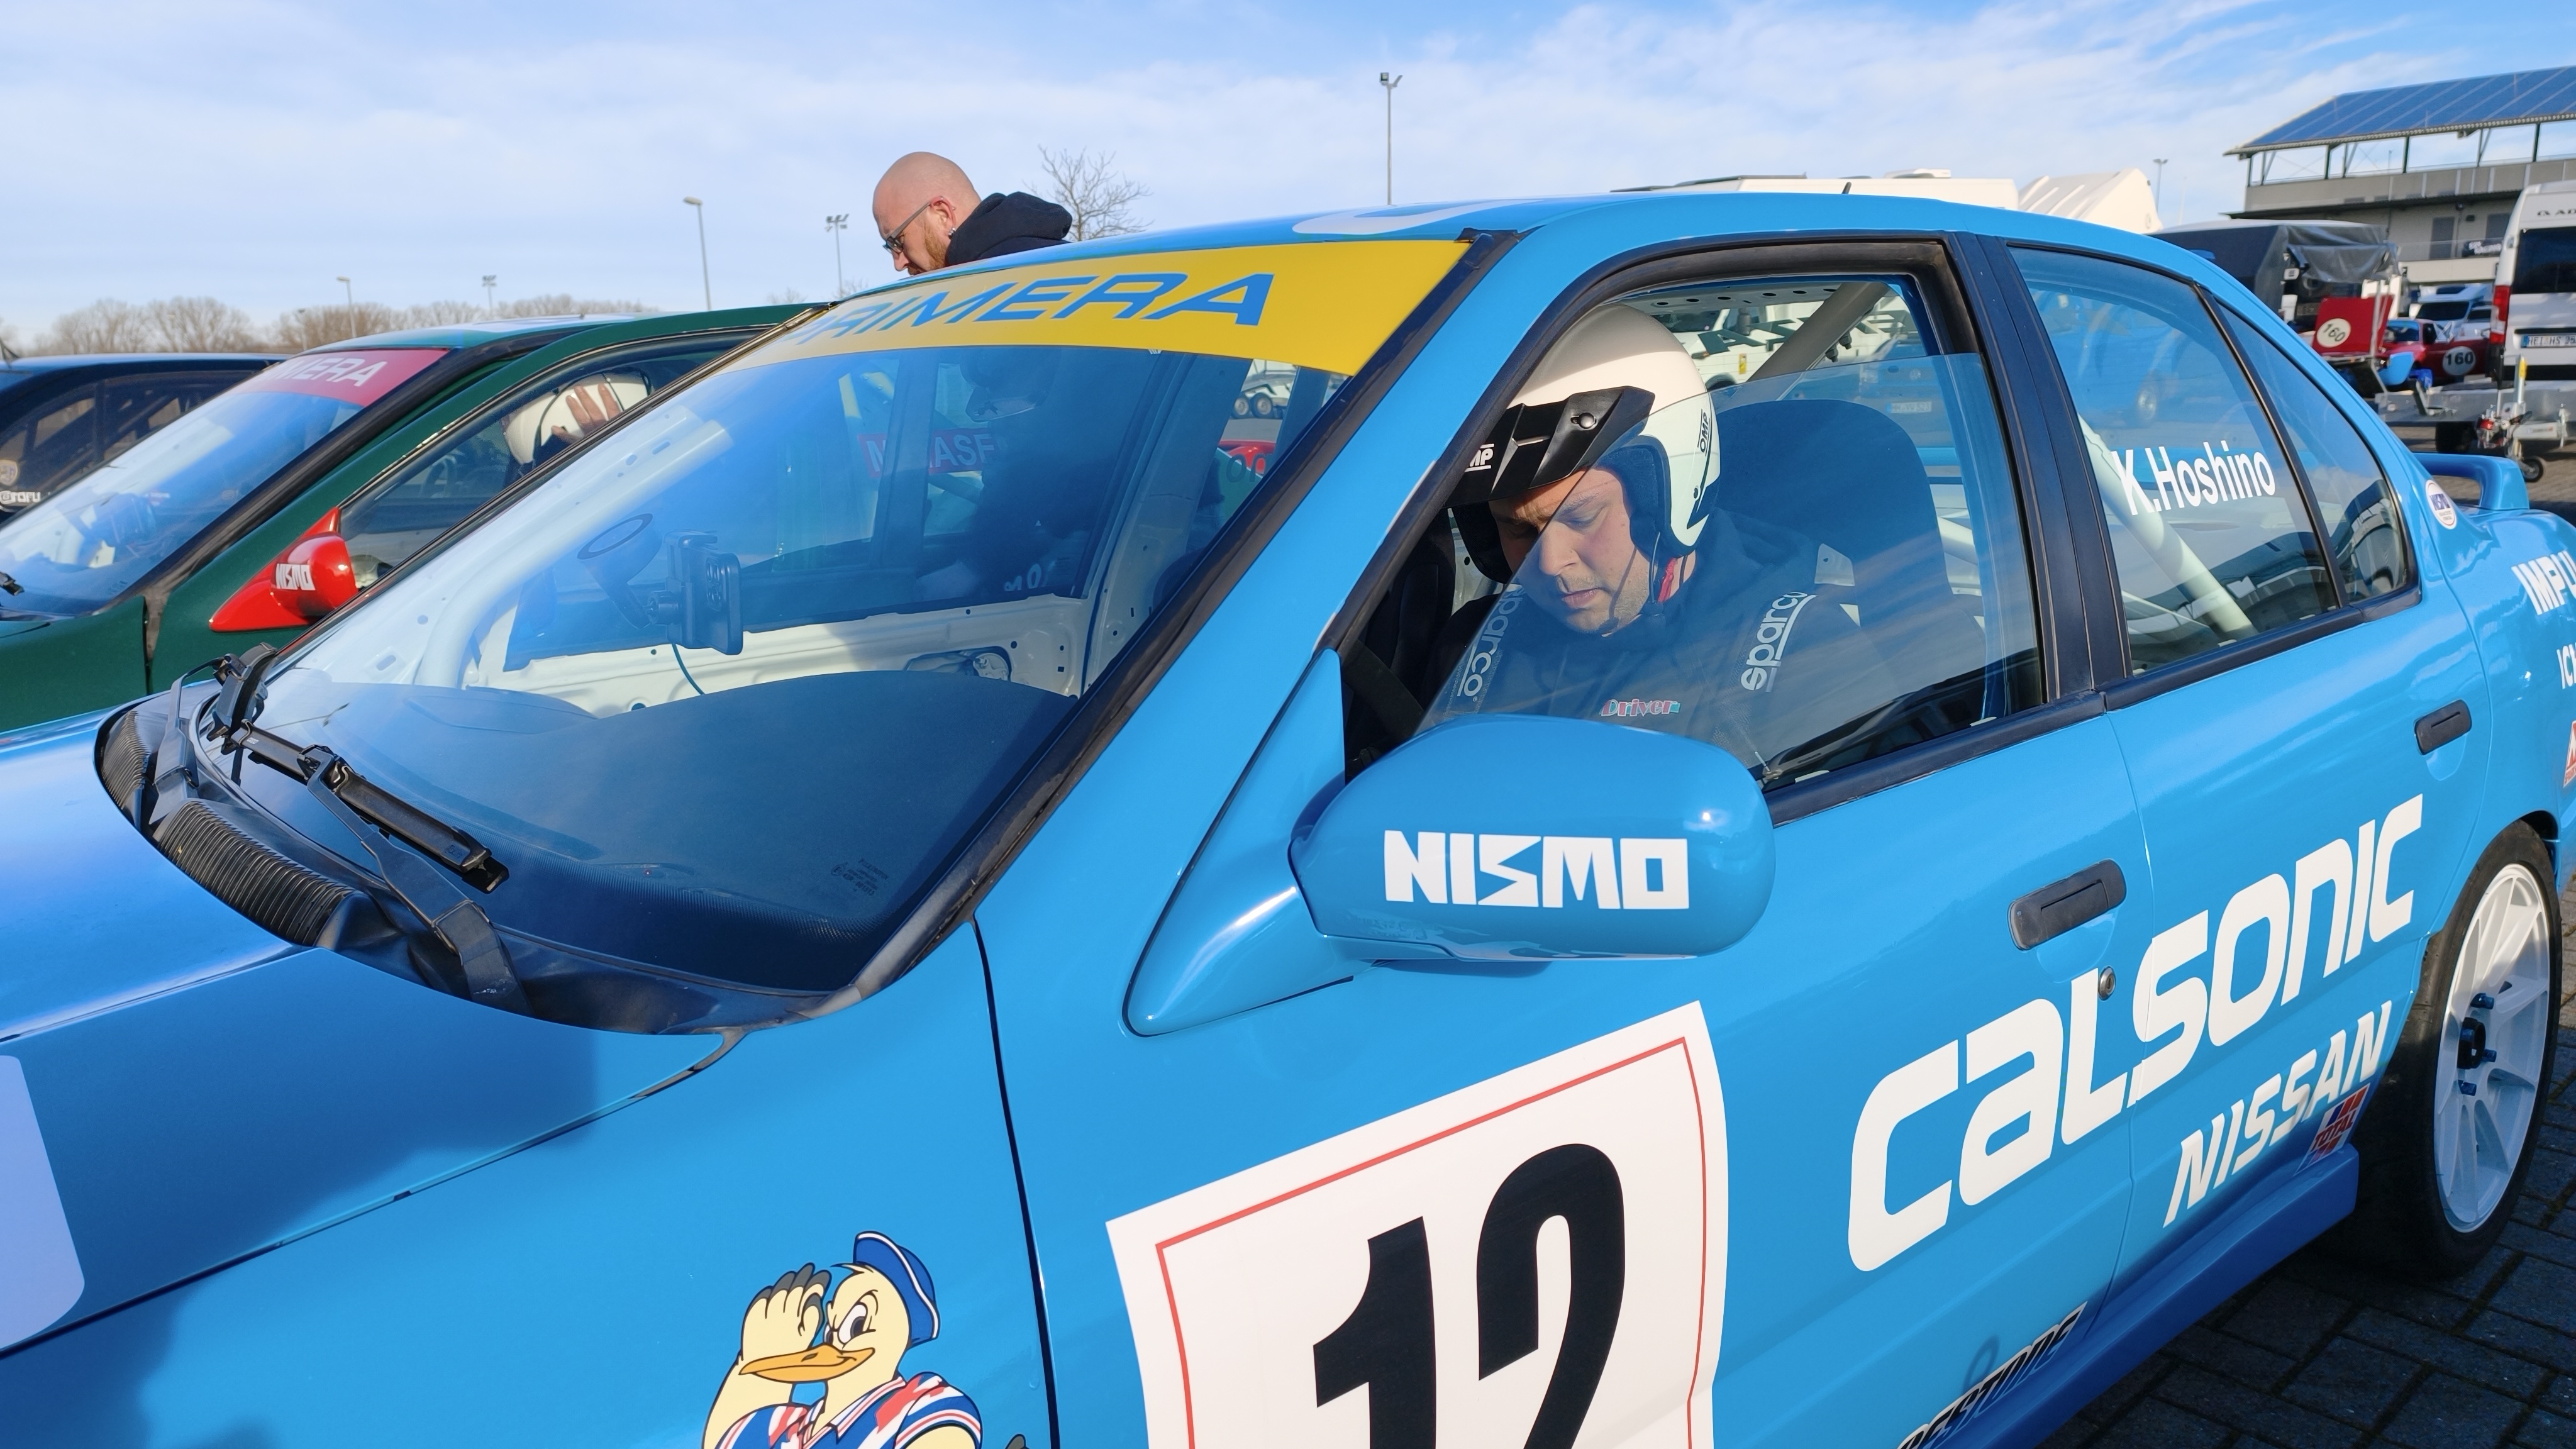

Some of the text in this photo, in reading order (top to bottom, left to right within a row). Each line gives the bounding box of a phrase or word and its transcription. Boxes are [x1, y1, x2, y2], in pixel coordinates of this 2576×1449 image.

[2323, 323, 2346, 341] 160
[2445, 352, 2473, 366] 160
[1699, 411, 1709, 453] OMP
[2111, 440, 2275, 515] K.Hoshino
[276, 564, 316, 591] NISMO
[2511, 551, 2576, 615] IMPU
[1601, 699, 1678, 717] Driver
[1384, 830, 1690, 909] NISMO
[2163, 1001, 2392, 1228] NISSAN
[1313, 1143, 1625, 1449] 12
